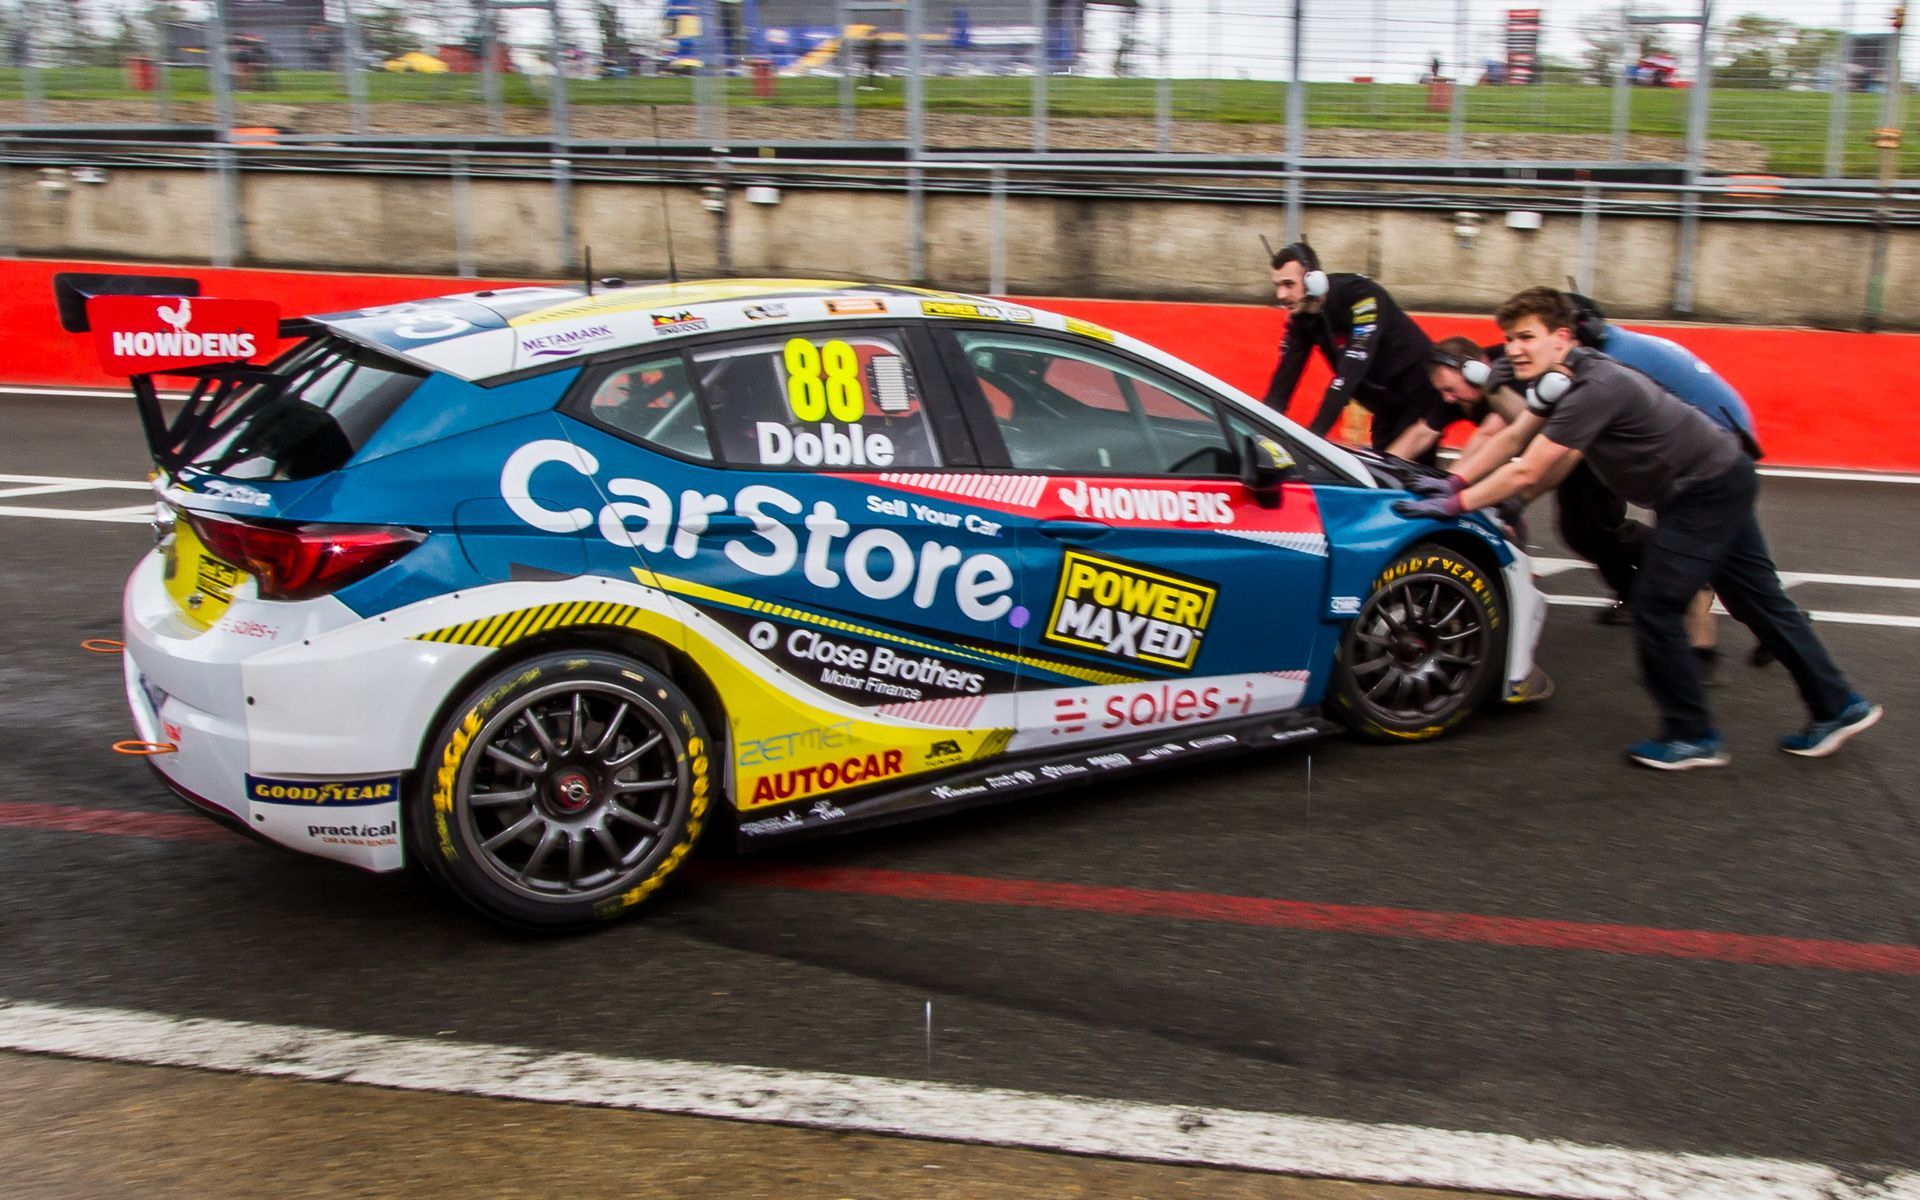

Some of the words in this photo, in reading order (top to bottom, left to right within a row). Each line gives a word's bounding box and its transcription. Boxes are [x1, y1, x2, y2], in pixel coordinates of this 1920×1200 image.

[112, 331, 257, 357] HOWDENS
[522, 325, 613, 351] METAMARK
[784, 337, 865, 422] 88
[756, 421, 895, 467] Doble
[866, 494, 908, 518] Sell
[910, 502, 962, 528] Your
[1089, 487, 1235, 524] HOWDENS
[1066, 562, 1203, 627] POWER
[1055, 598, 1198, 659] MAXED
[786, 629, 868, 670] Close
[868, 646, 985, 694] Brothers
[820, 667, 866, 690] Motor
[866, 676, 922, 700] Finance
[254, 783, 393, 804] GOODYEAR
[751, 749, 904, 804] AUTOCAR
[307, 820, 397, 837] practical
